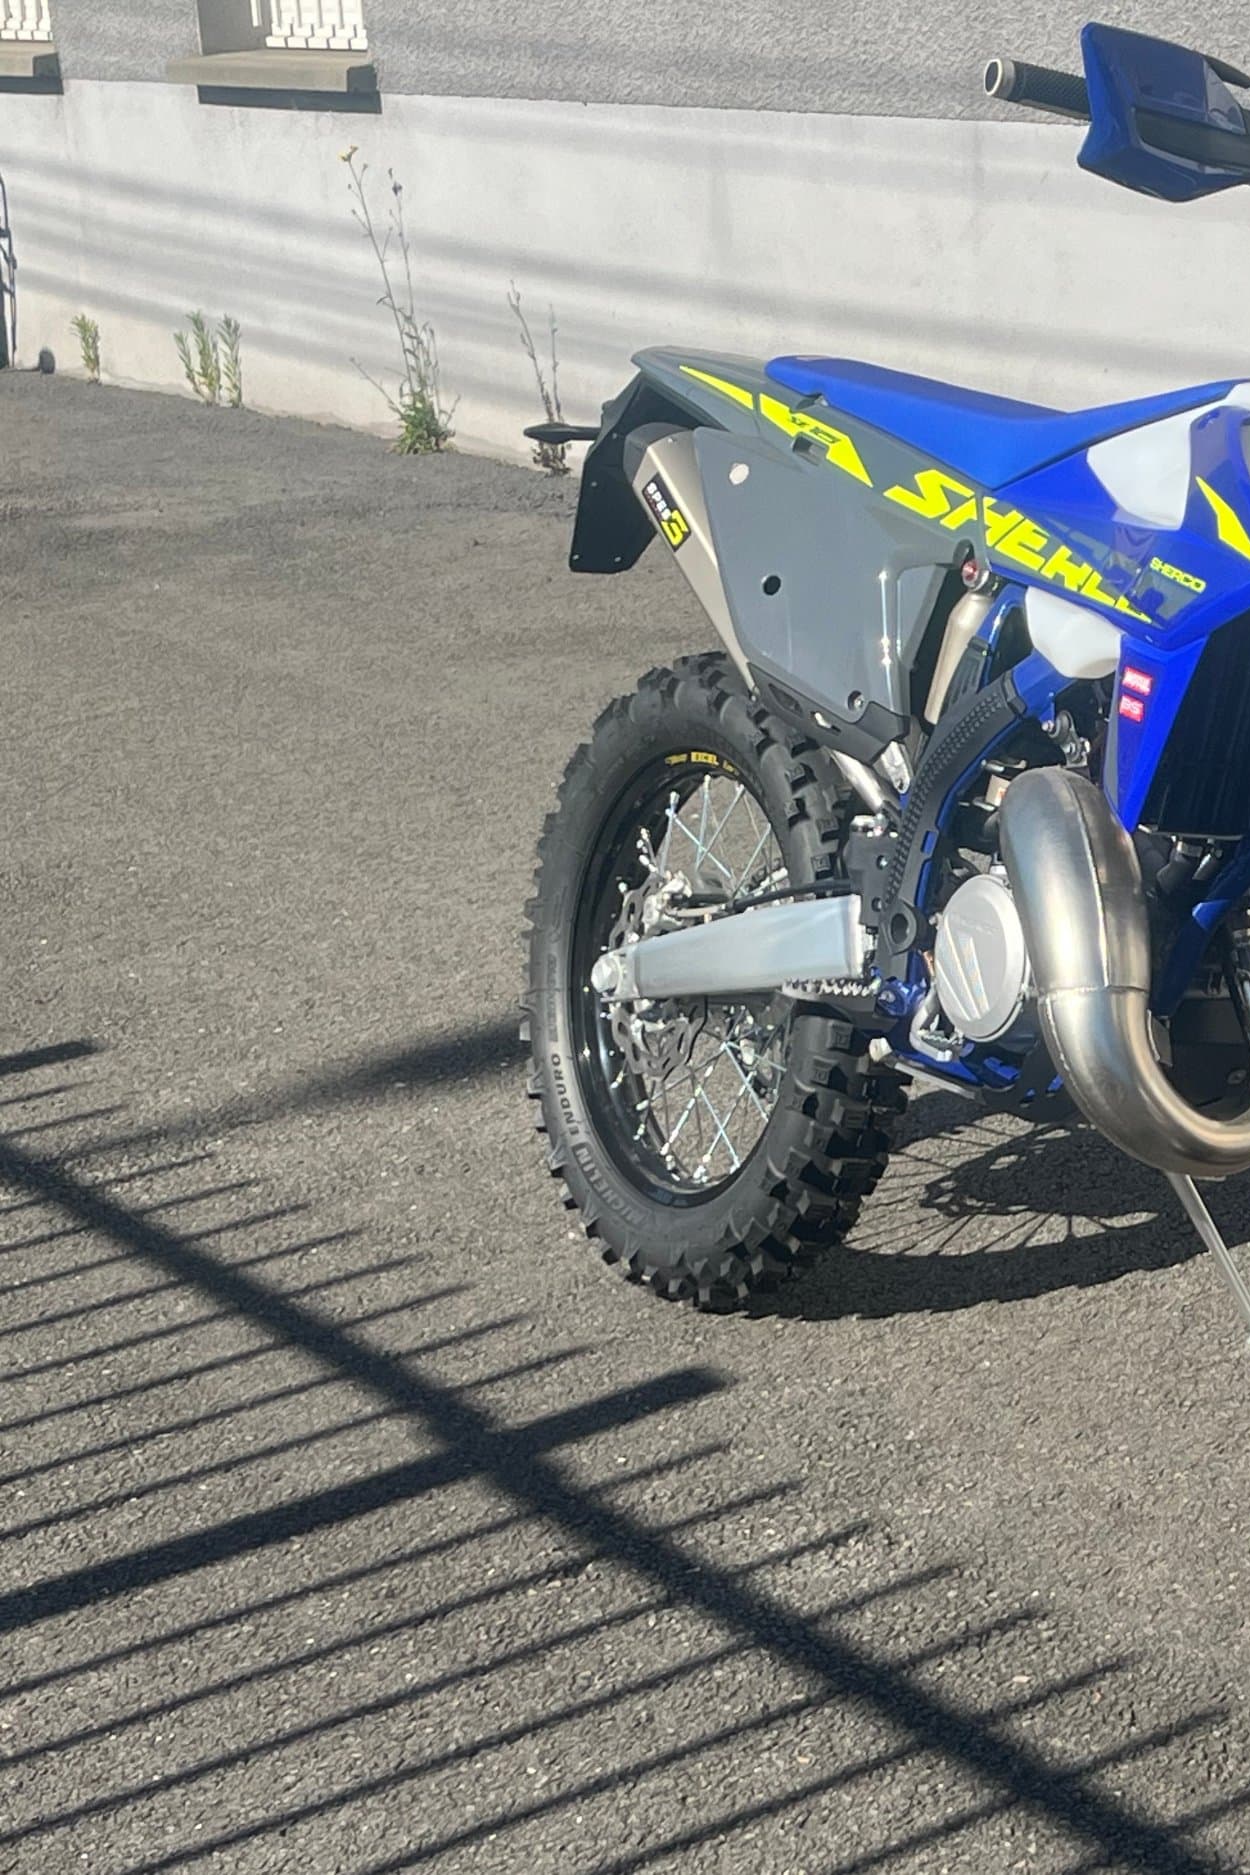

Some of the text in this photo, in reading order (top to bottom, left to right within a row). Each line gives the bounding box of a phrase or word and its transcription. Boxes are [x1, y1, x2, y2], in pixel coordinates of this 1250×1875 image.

[1149, 557, 1207, 594] SHERCO
[552, 1053, 648, 1229] MICHELIN ENDURO
